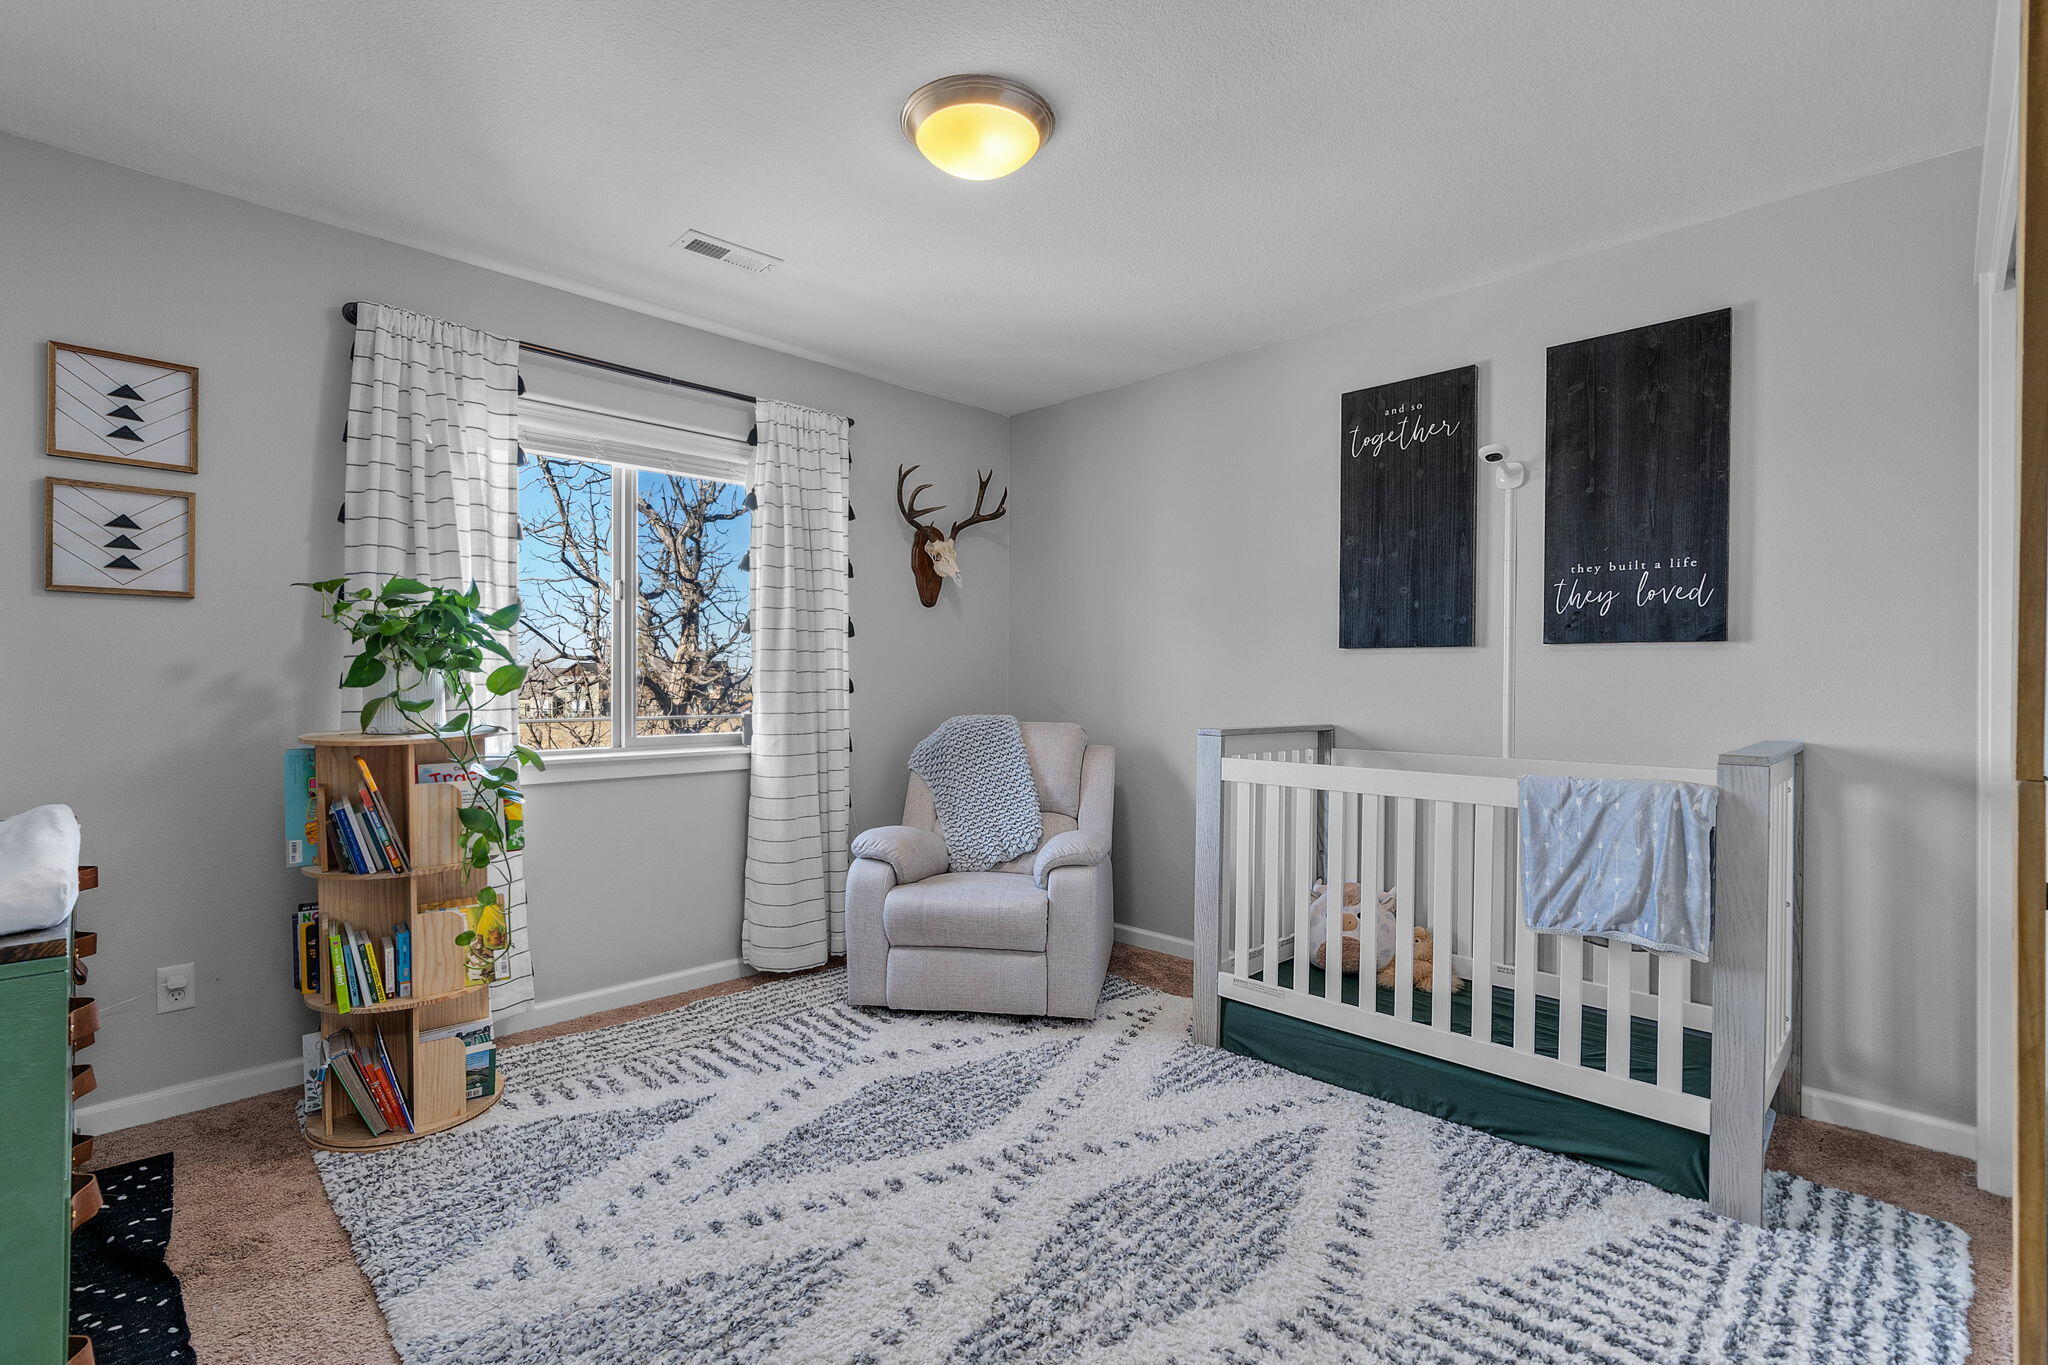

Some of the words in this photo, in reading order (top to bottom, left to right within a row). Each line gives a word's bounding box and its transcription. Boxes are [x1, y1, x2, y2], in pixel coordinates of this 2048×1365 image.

[1384, 404, 1405, 416] and
[1410, 403, 1423, 411] so
[1349, 414, 1460, 458] together
[1570, 563, 1602, 575] they
[1609, 560, 1646, 571] built
[1654, 561, 1661, 569] a
[1669, 557, 1698, 568] life
[1553, 578, 1620, 617] they
[1636, 571, 1714, 608] loved
